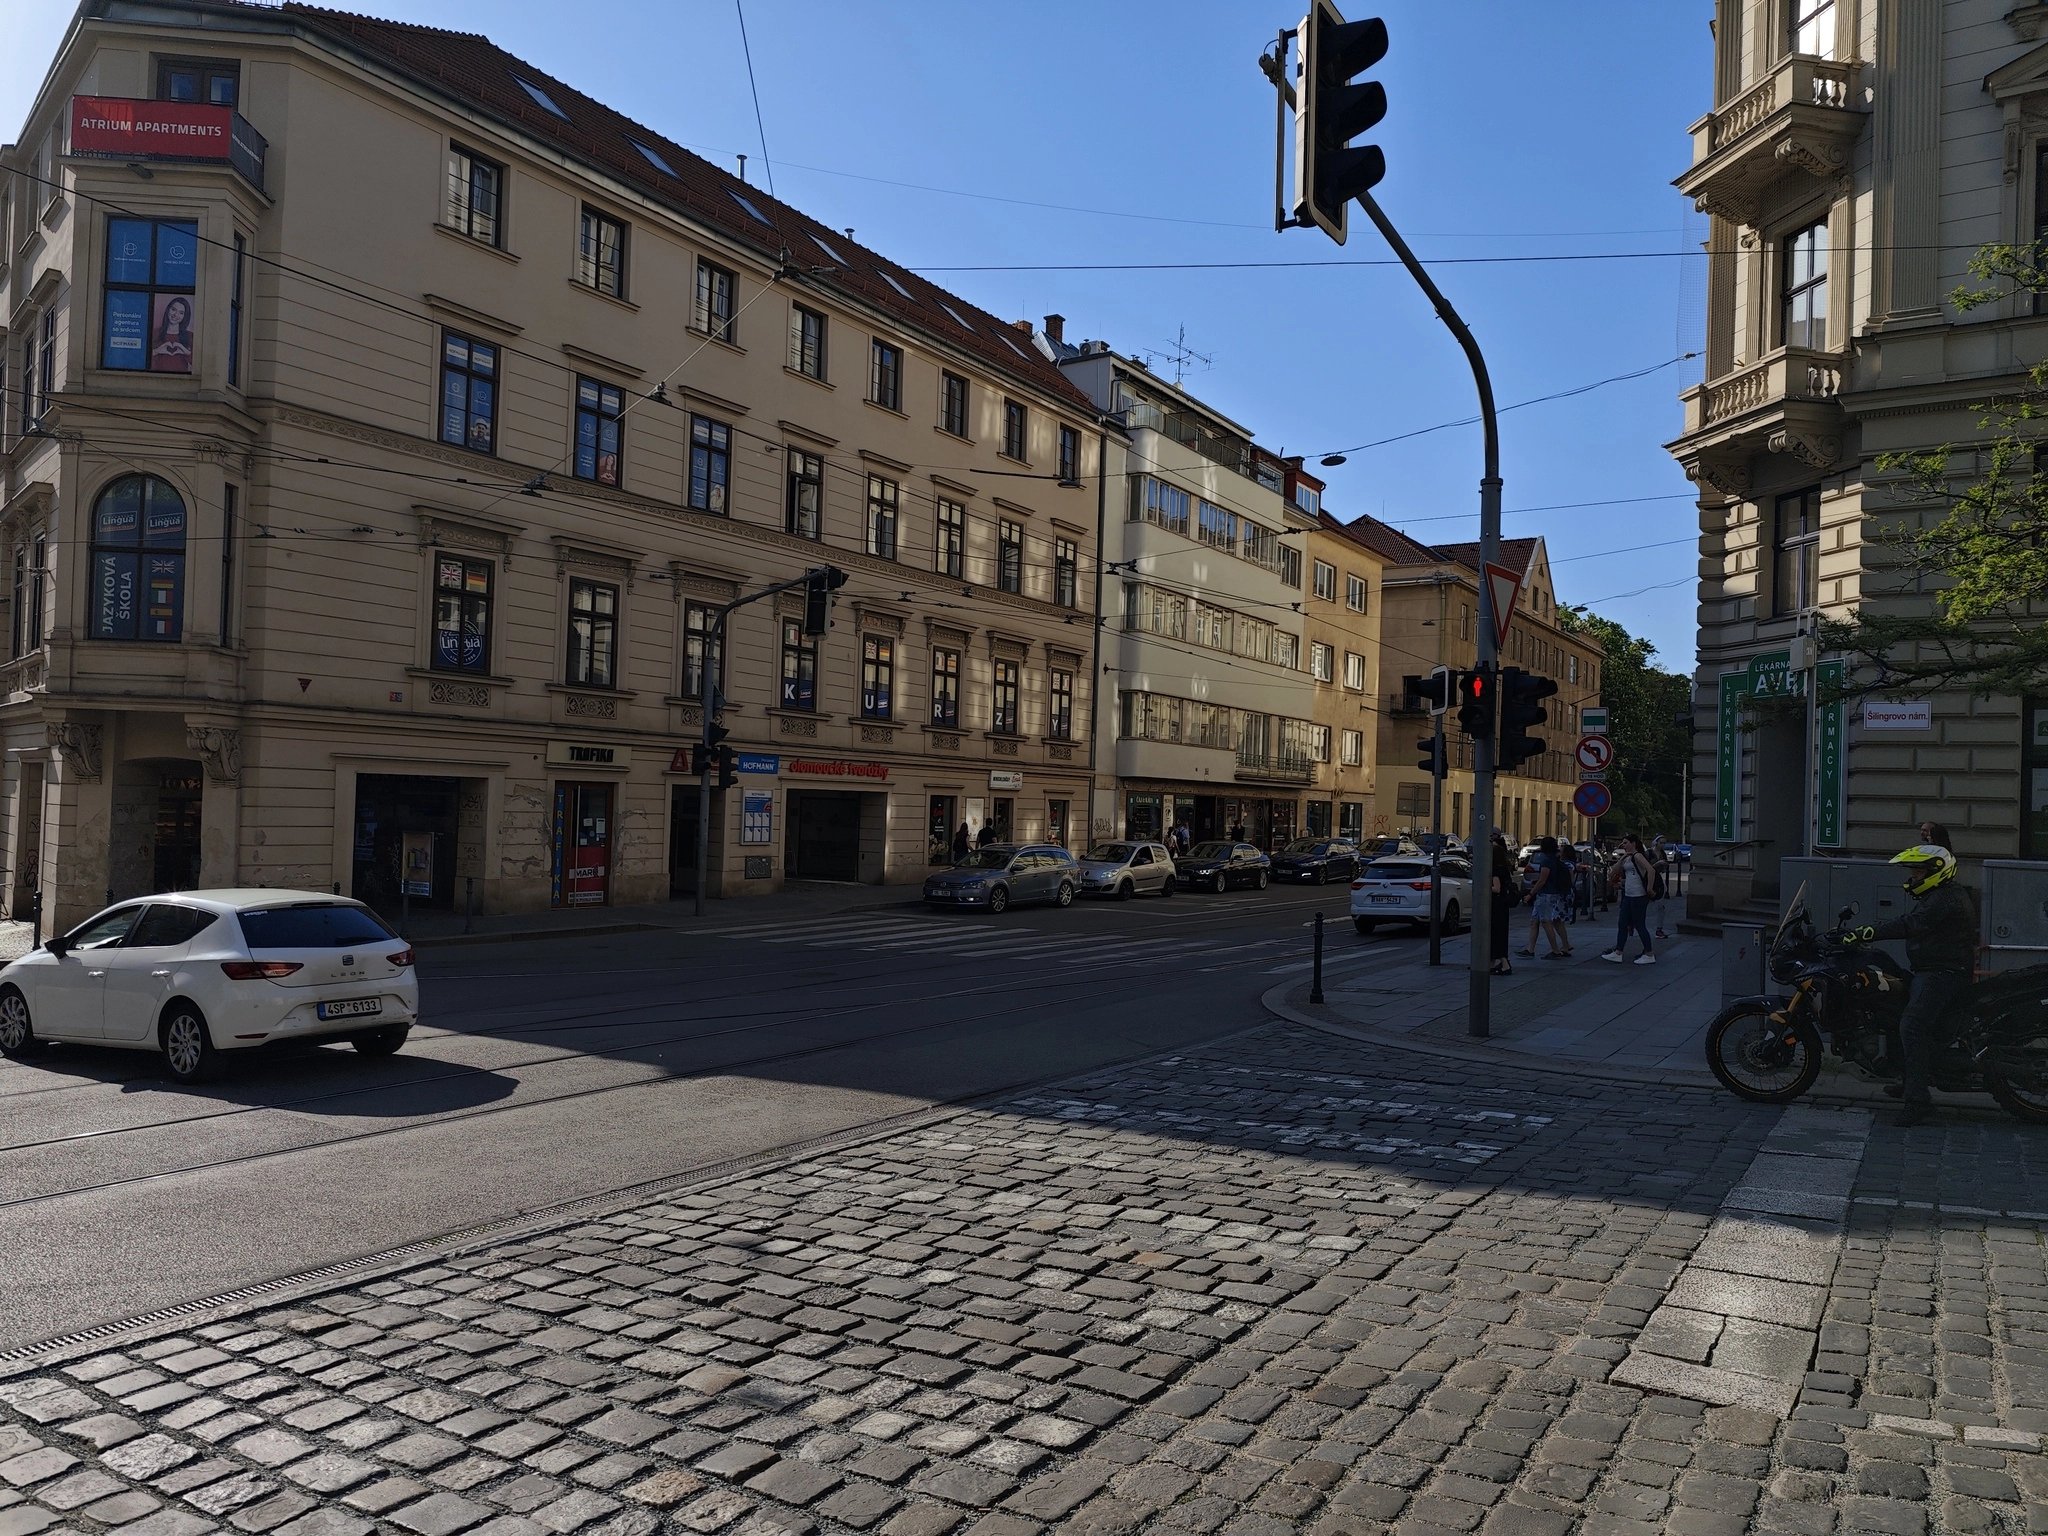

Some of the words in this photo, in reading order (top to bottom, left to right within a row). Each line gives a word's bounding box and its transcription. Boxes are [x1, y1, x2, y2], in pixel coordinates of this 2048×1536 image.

[81, 118, 131, 131] ATRIUM
[135, 121, 222, 137] APARTMENTS
[103, 515, 134, 526] Lingua
[149, 517, 181, 528] Lingua
[102, 556, 116, 633] JAZYKOVÁ
[116, 572, 132, 619] ŠKOLA
[784, 683, 796, 700] K
[865, 694, 875, 710] U
[934, 703, 943, 718] R
[995, 712, 1004, 726] Z
[1051, 718, 1059, 731] Y
[1868, 710, 1906, 722] Šilingrovo
[1908, 711, 1928, 721] nám.
[569, 746, 614, 762] TRAFIKA
[743, 762, 776, 772] HOFMANN
[790, 759, 845, 776] olomoucké
[1825, 800, 1833, 837] AVE
[553, 794, 564, 898] TRAFIKA
[328, 1002, 346, 1015] 4SP
[353, 1000, 377, 1012] 6133
